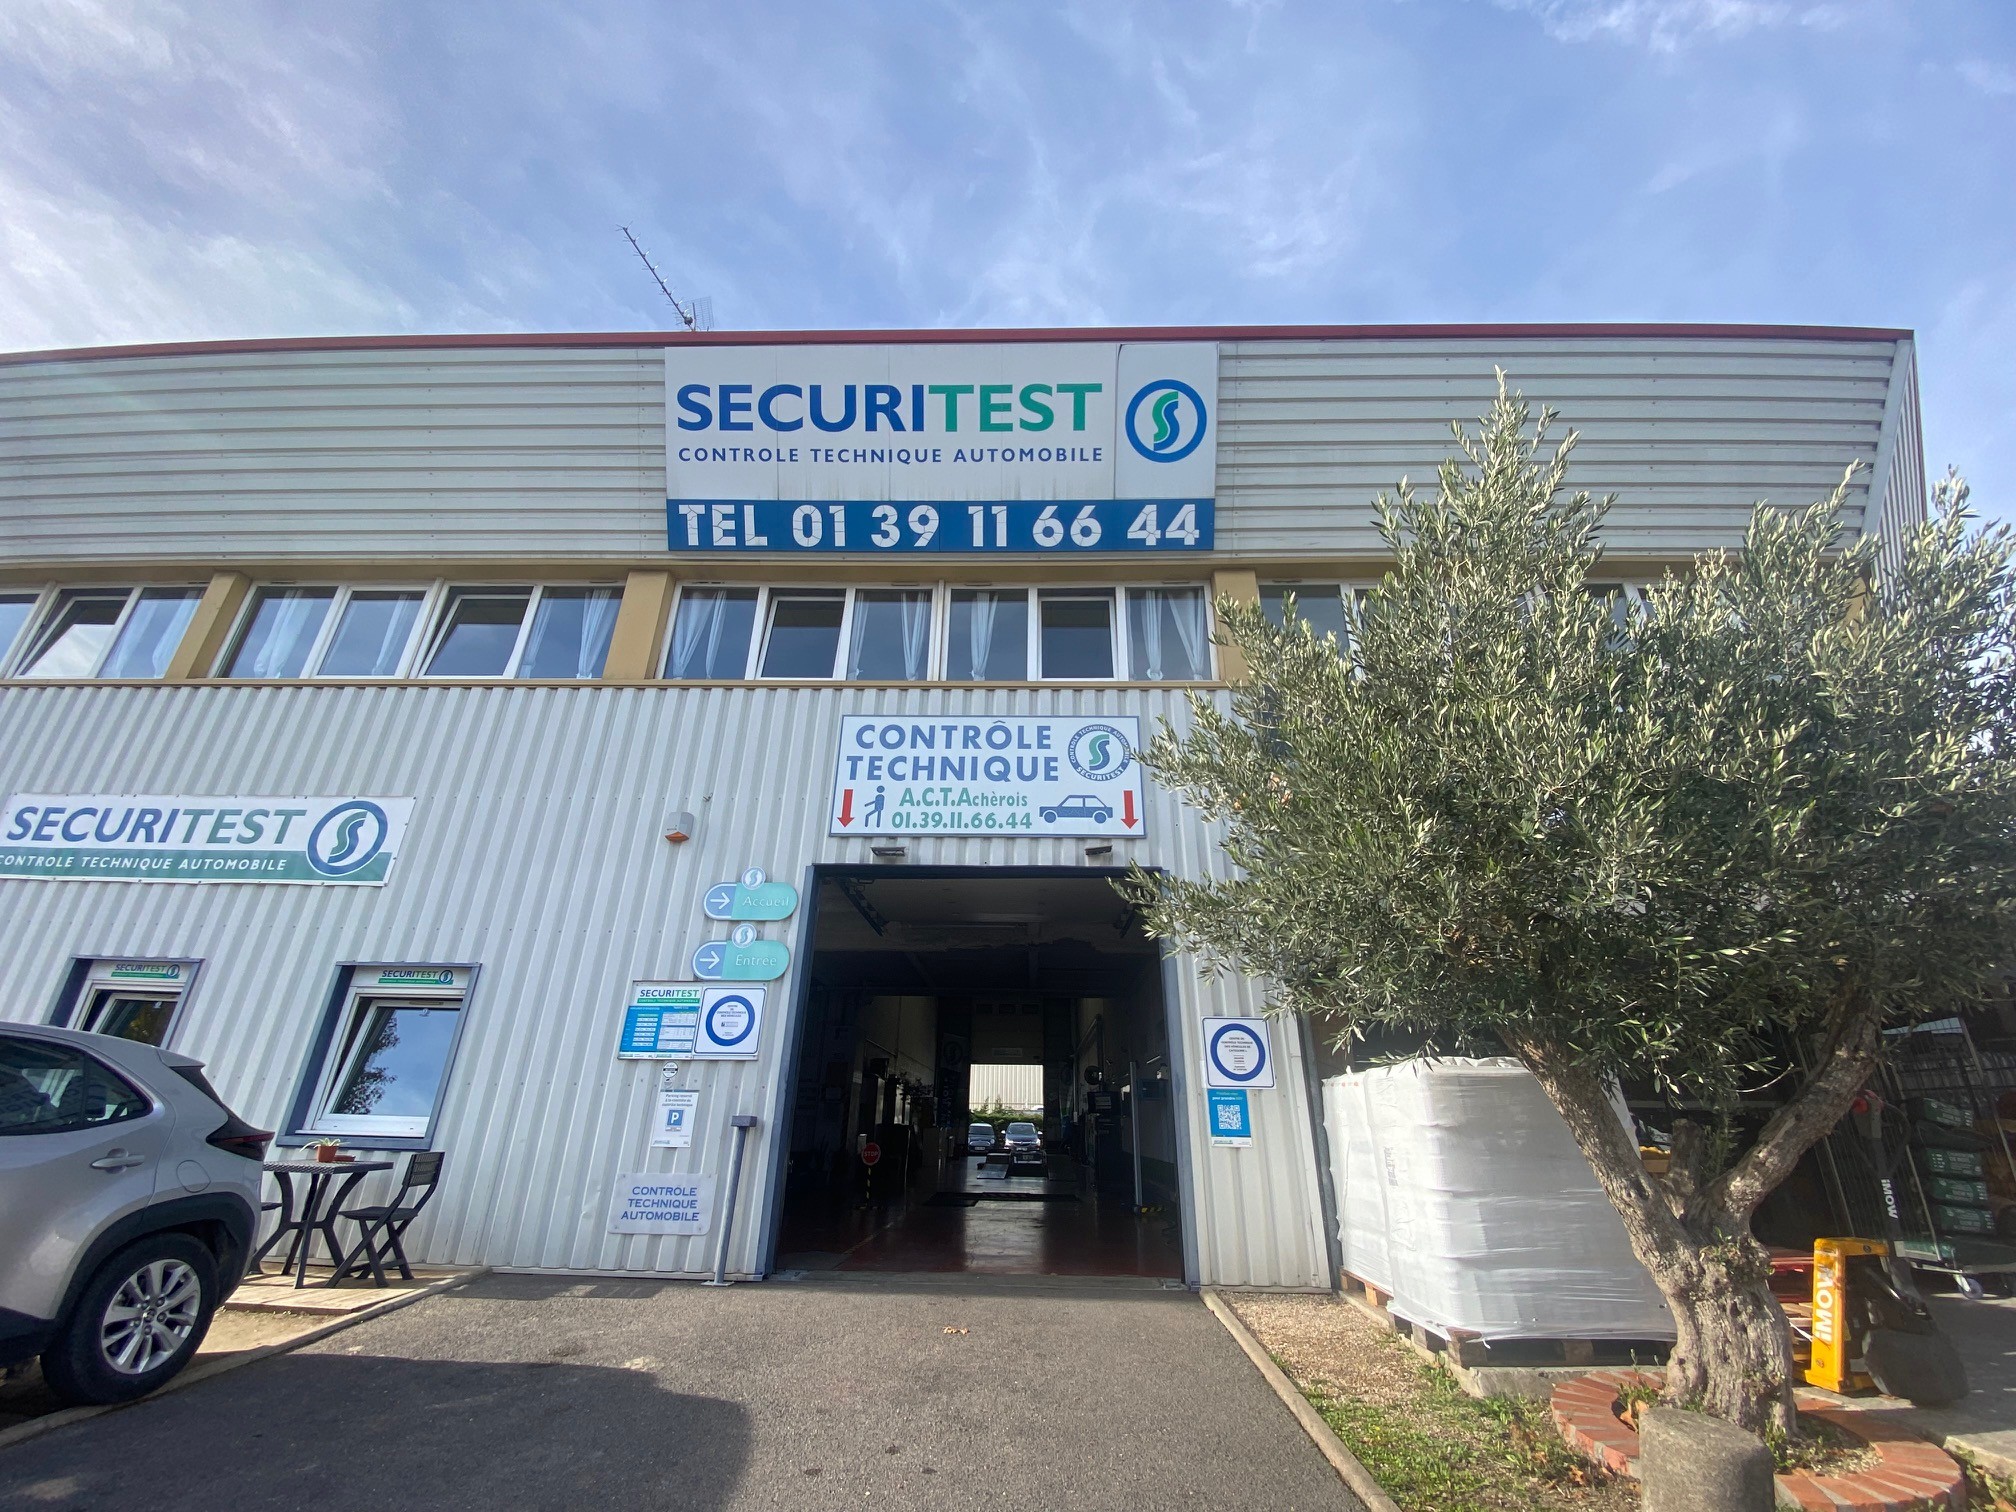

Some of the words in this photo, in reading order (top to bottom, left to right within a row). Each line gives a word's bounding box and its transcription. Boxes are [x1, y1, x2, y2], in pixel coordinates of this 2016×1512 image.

[676, 383, 1102, 432] SECURITEST
[678, 447, 799, 462] CONTROLE
[810, 448, 942, 465] TECHNIQUE
[953, 448, 1102, 462] AUTOMOBILE
[678, 504, 767, 547] TEL
[792, 505, 846, 547] 01
[871, 505, 940, 548] 39
[968, 505, 1007, 547] 11
[1033, 505, 1102, 547] 66
[1127, 504, 1200, 546] 44
[856, 720, 1051, 750] CONTRÔLE
[846, 755, 1059, 782] TECHNIQUE
[1076, 766, 1125, 781] SECURITEST
[6, 806, 307, 844] SECURITEST
[891, 811, 1033, 829] 01.39.11.66.44
[81, 857, 172, 870] TECHNIQUE
[178, 858, 287, 871] AUTOMOBILE
[742, 896, 790, 907] Accueil
[114, 963, 168, 972] SECURITEST
[381, 970, 439, 978] SECURITEST
[639, 989, 700, 997] SECURITEST
[628, 1198, 698, 1209] TECHNIQUE
[621, 1210, 700, 1222] AUTOMOBILE
